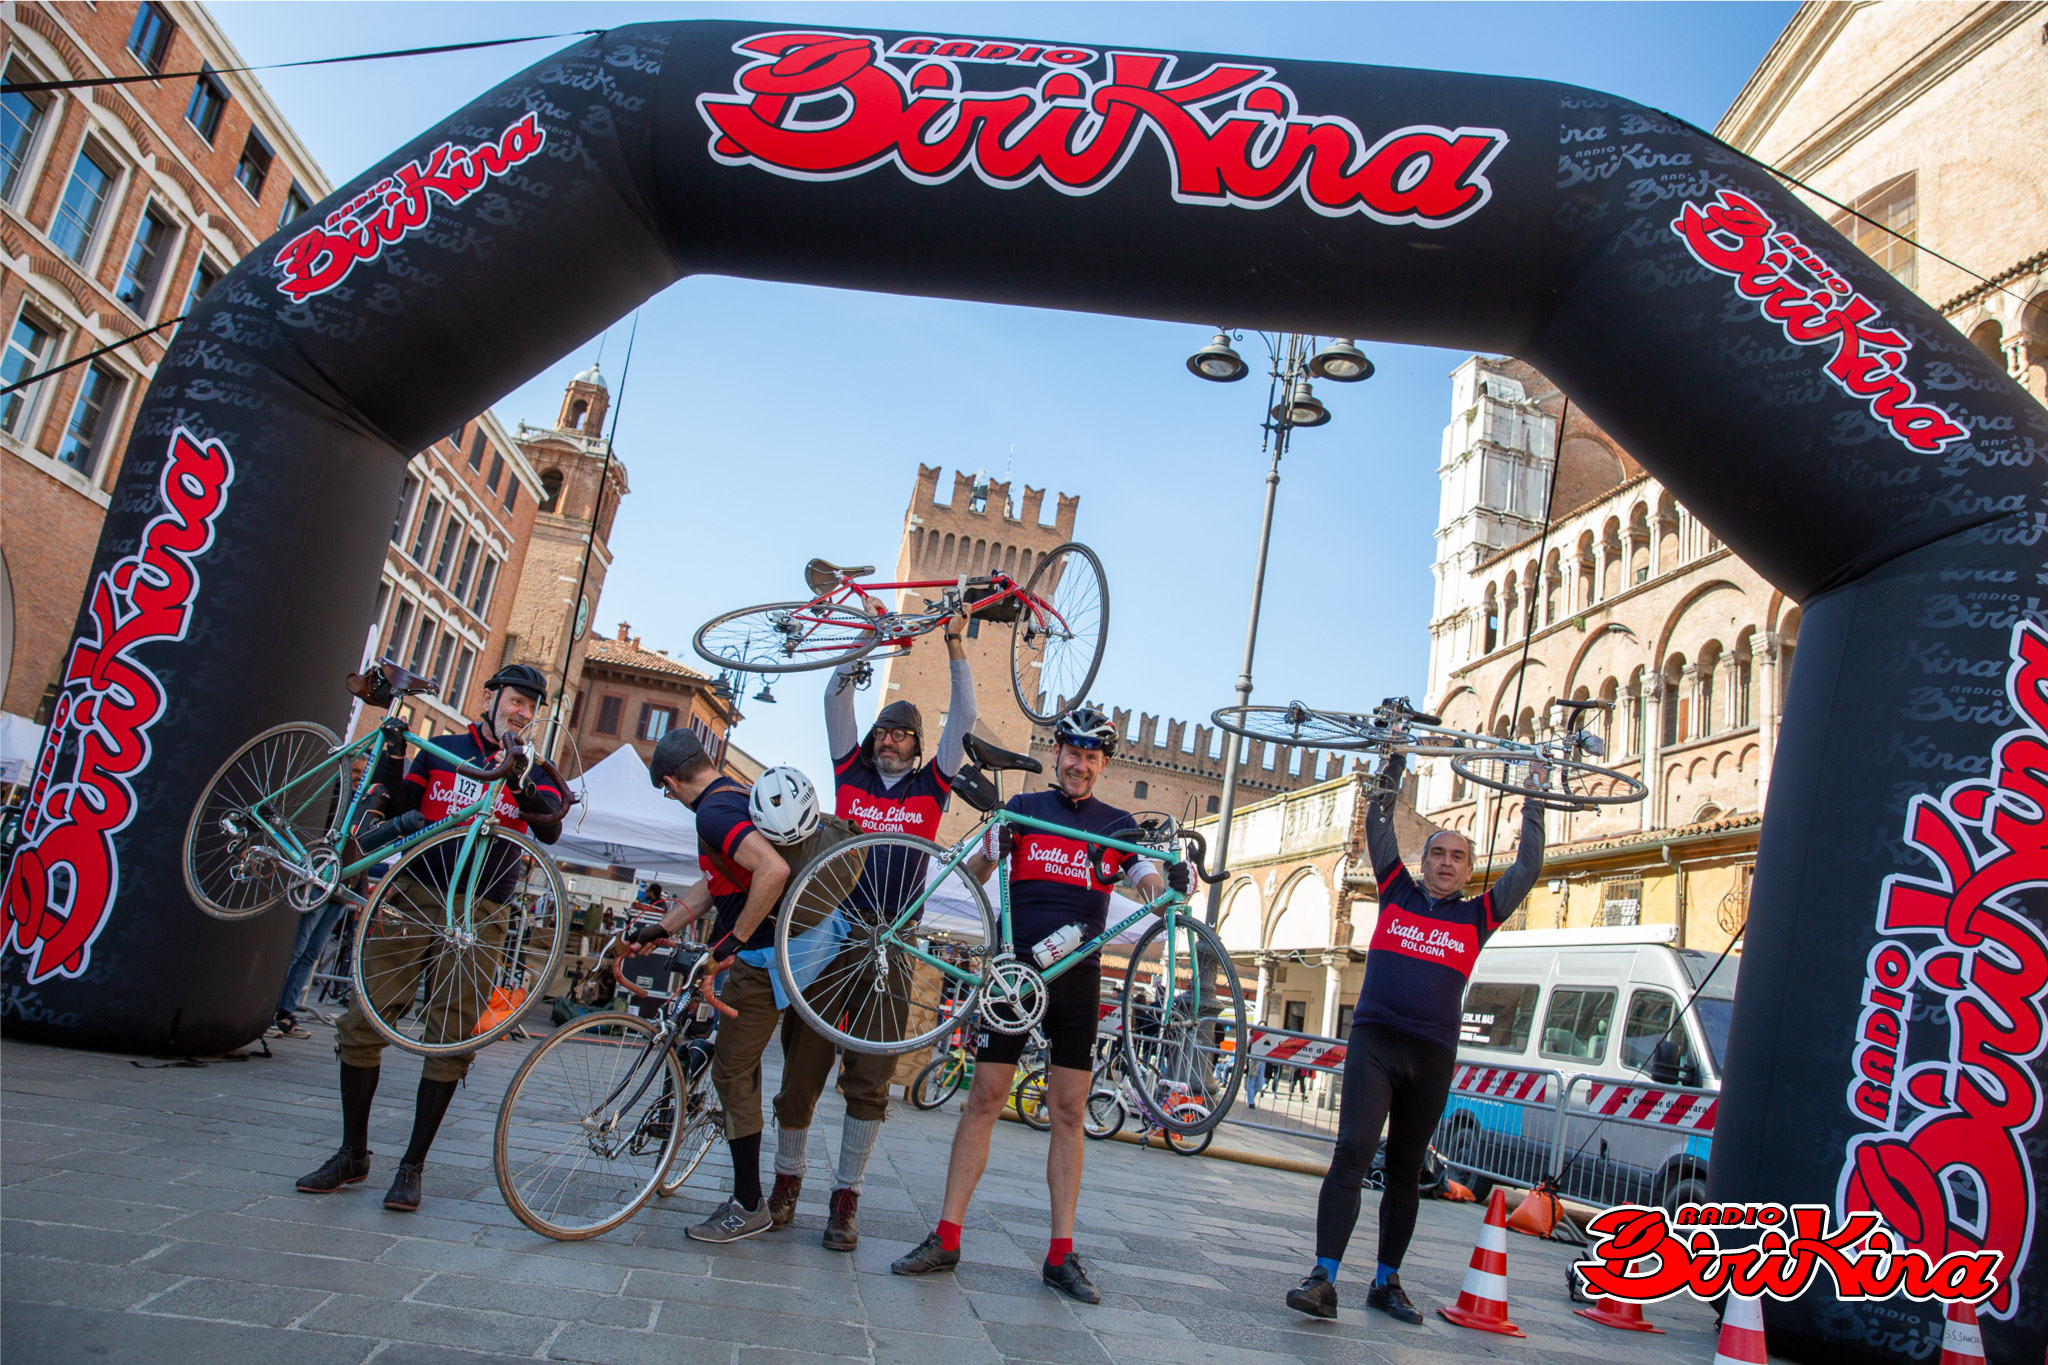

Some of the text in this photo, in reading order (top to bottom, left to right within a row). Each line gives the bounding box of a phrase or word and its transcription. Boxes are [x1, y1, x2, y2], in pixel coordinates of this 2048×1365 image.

[896, 38, 1095, 66] RADIO
[699, 33, 1504, 226] BiriKina
[1575, 145, 1617, 159] RADIO
[275, 112, 547, 302] BiriKina
[326, 178, 395, 228] RADIO
[1777, 234, 1852, 295] RADIO
[235, 313, 269, 326] RADIO
[314, 301, 355, 319] RADIO
[1670, 190, 1970, 454] BiriKina
[1766, 368, 1813, 382] RADIO
[217, 381, 258, 394] RADIO
[1965, 592, 2021, 602] RADIO
[1950, 685, 2006, 696] RADIO
[24, 690, 72, 840] RADIO
[458, 778, 478, 799] 127
[848, 798, 924, 825] Scatto Libero
[861, 819, 904, 833] BOLOGNA
[1028, 842, 1069, 864] Scatto
[1099, 905, 1150, 942] Bianchi
[1386, 918, 1465, 953] Scatto Libero
[1400, 938, 1445, 958] BOLOGNA
[1848, 939, 1918, 1131] RADIO
[1316, 1047, 1326, 1055] di
[1633, 1095, 1708, 1115] Comune di Ferrara
[1862, 1303, 1921, 1324] RADIO
